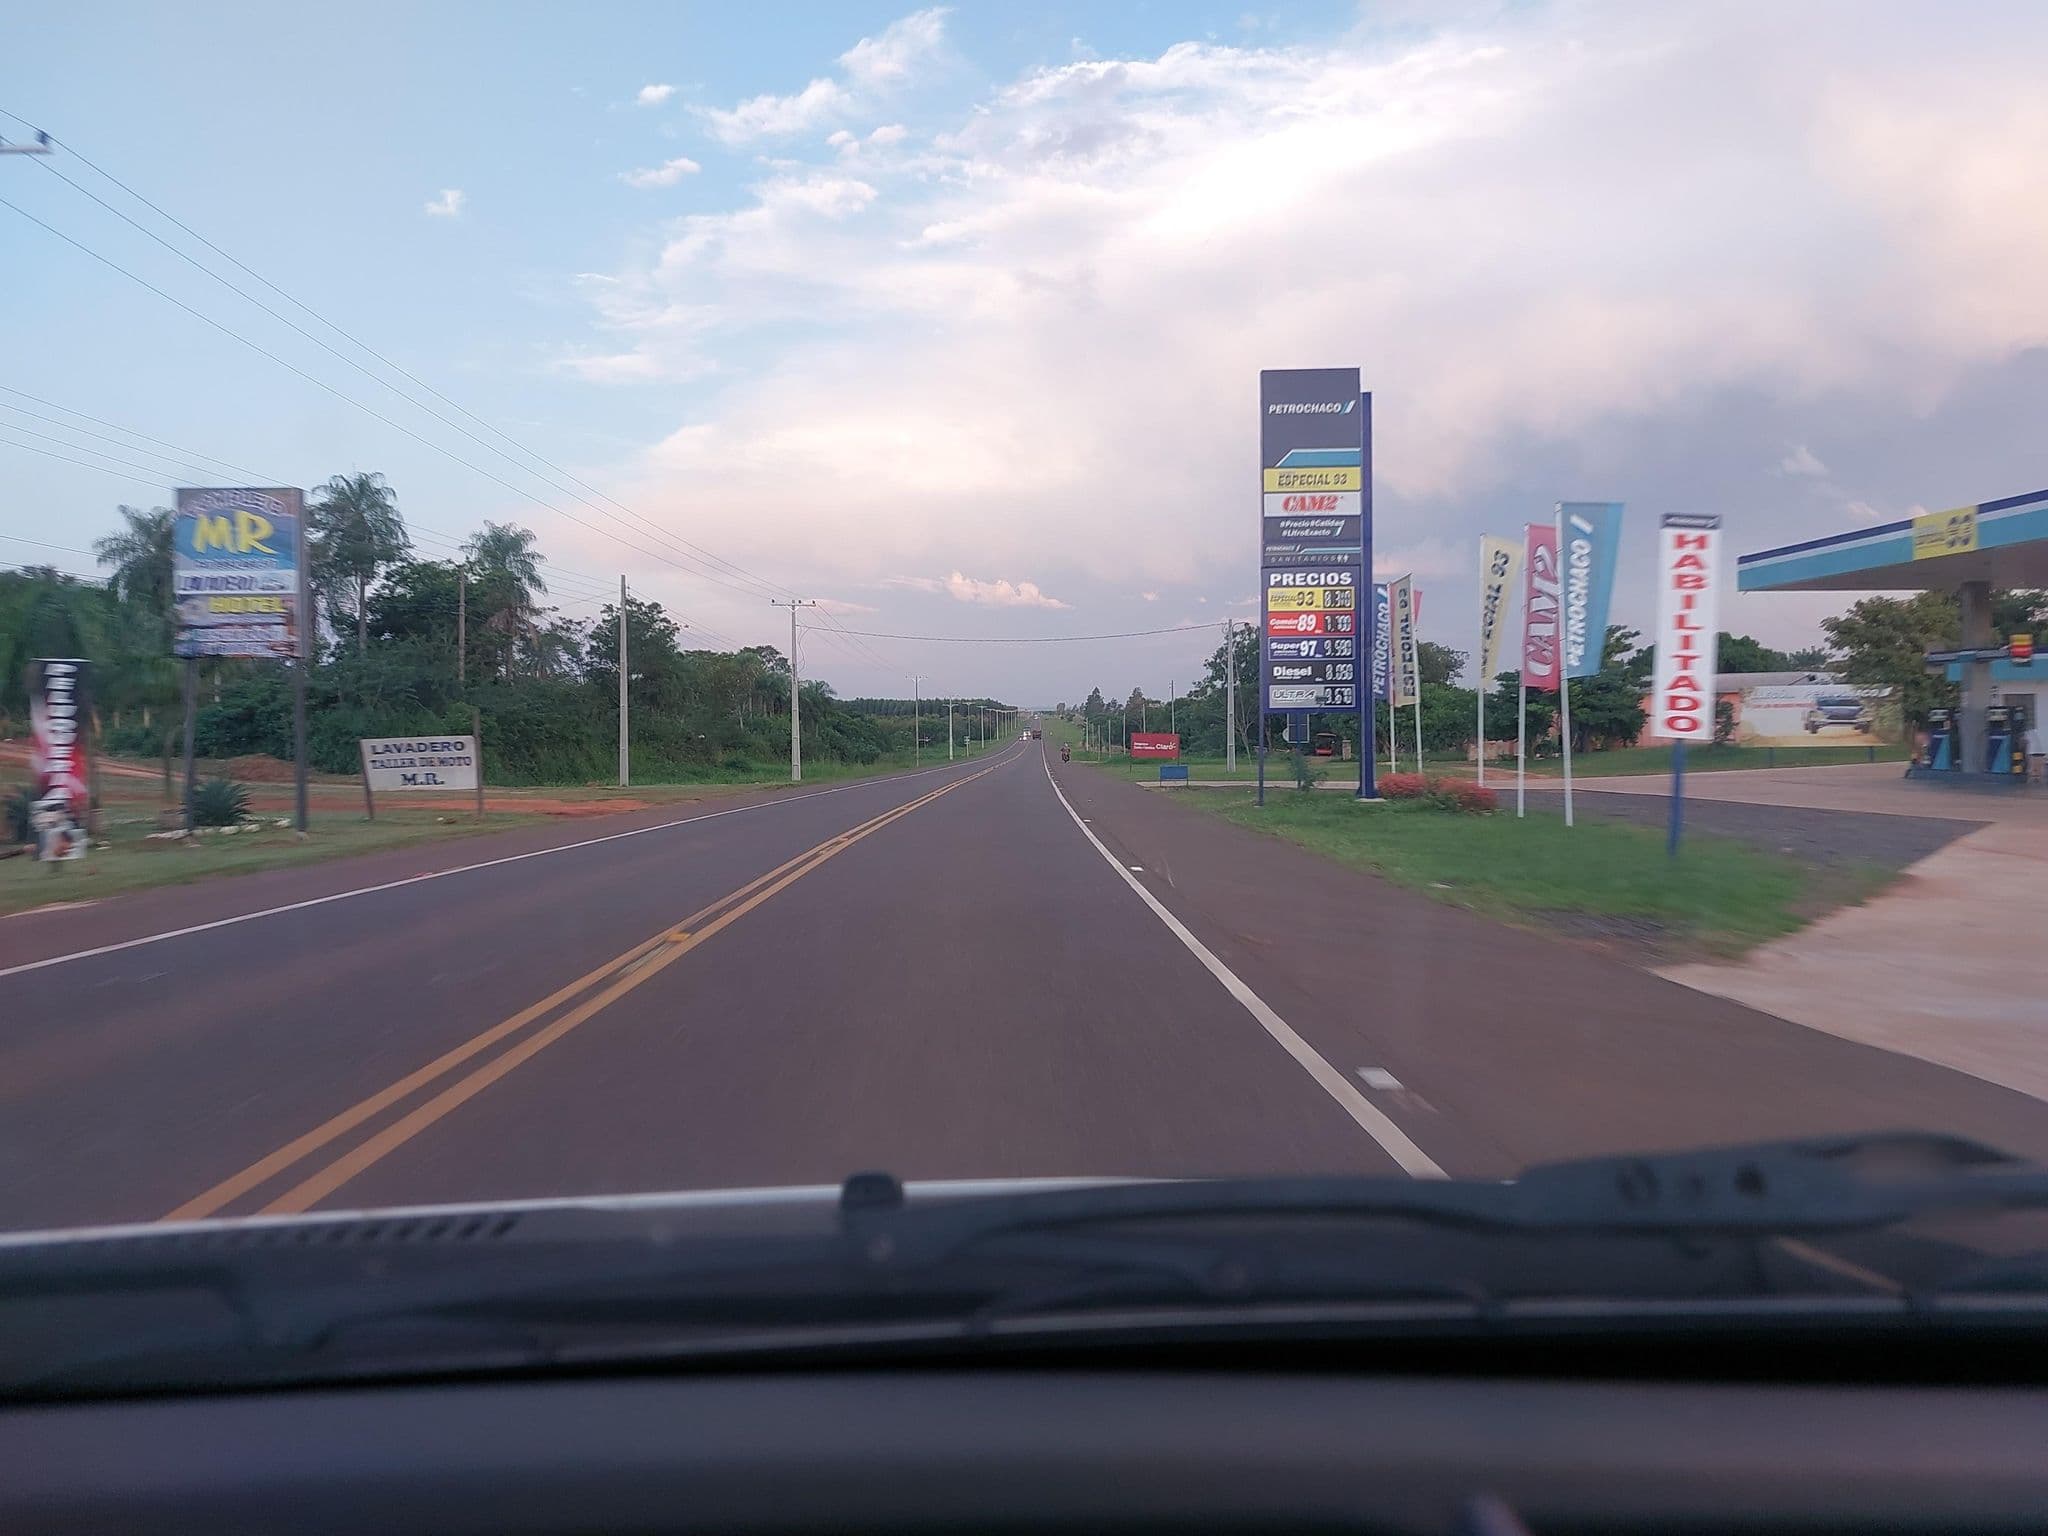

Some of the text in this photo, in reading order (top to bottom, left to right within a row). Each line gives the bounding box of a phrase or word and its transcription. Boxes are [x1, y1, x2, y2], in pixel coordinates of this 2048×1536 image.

[1268, 403, 1341, 415] PETROCHACO
[1278, 473, 1348, 487] ESPECIAL 93
[1282, 495, 1338, 512] CAM2
[192, 509, 279, 554] MR
[1271, 555, 1336, 563] SANITARIOS
[1269, 572, 1352, 586] PRECIOS
[1296, 591, 1314, 607] 93
[1566, 538, 1593, 667] PETROCHACO
[1526, 544, 1559, 677] CAM2
[1297, 614, 1316, 632] 89
[1662, 533, 1710, 733] HABILITADO
[1270, 641, 1301, 651] Super
[1299, 640, 1317, 657] 97
[1272, 665, 1313, 677] Diesel
[1272, 688, 1316, 700] ULTRA
[370, 741, 465, 755] LAVADERO
[1155, 742, 1174, 750] Claro
[418, 756, 435, 767] DE
[437, 756, 472, 767] MOTO
[400, 772, 445, 786] M.R.
